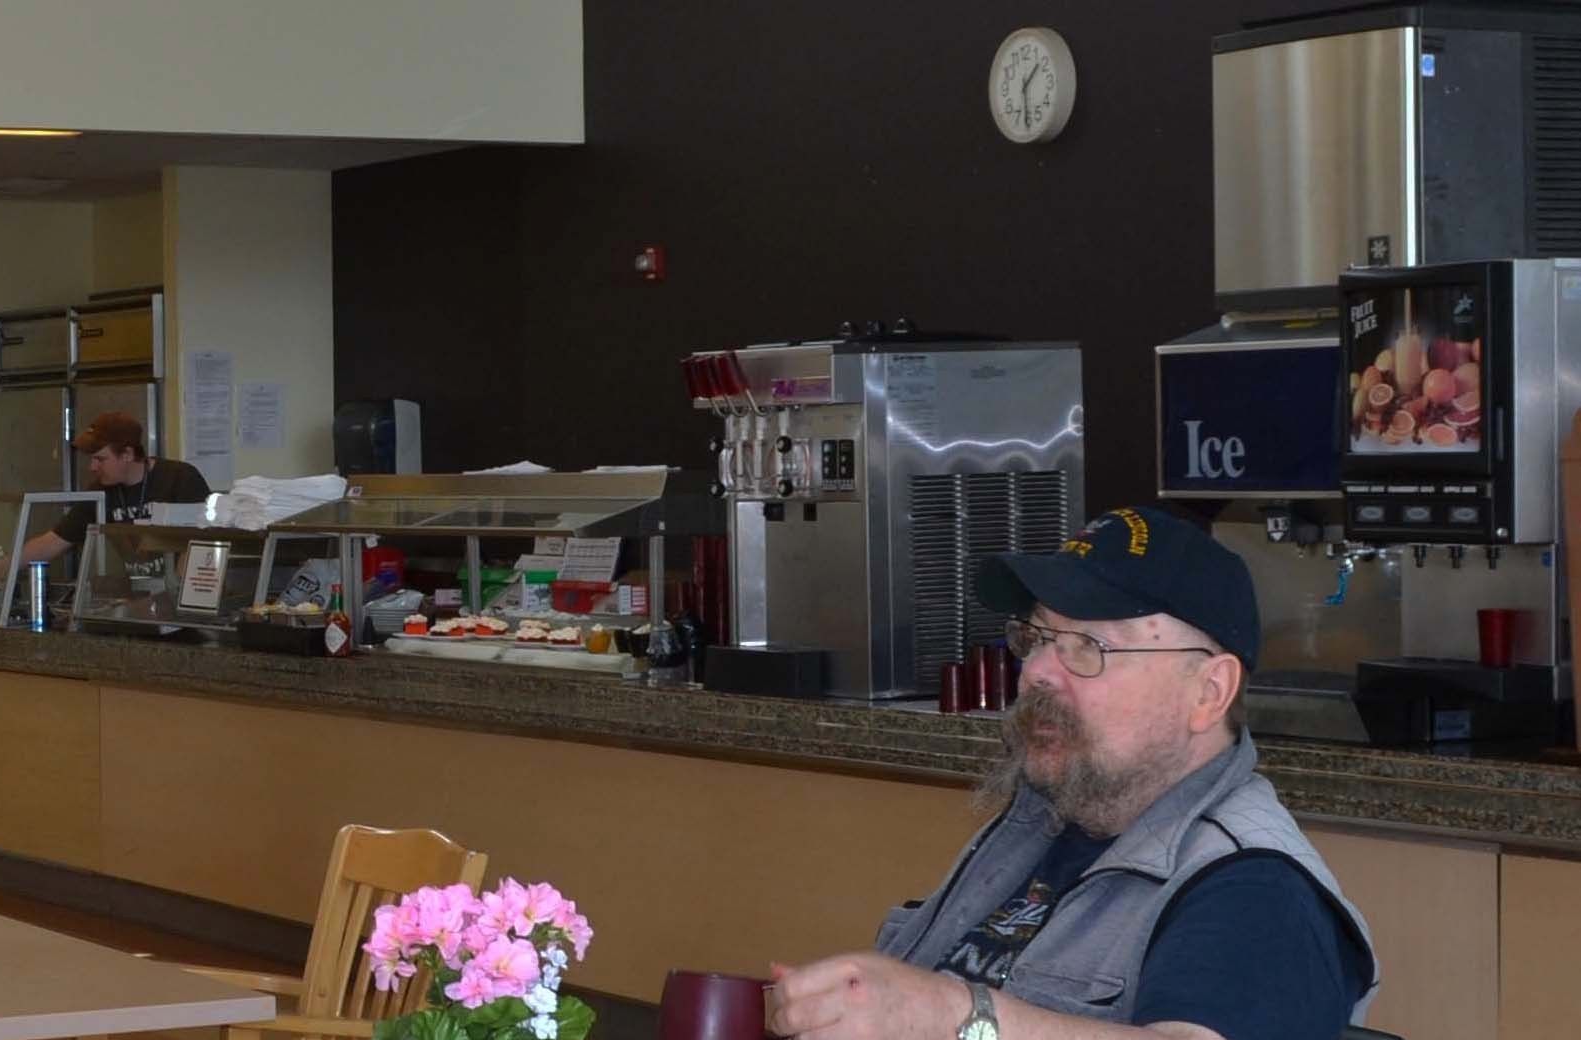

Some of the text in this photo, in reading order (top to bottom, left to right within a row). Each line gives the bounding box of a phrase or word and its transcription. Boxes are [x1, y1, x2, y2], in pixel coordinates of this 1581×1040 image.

[1011, 52, 1020, 65] 11
[1020, 44, 1032, 61] 12
[1040, 56, 1050, 73] 2
[1001, 81, 1009, 97] 9
[1045, 74, 1055, 91] 3
[1043, 93, 1051, 108] 4
[1013, 109, 1021, 126] 7
[1033, 105, 1042, 122] 5
[1184, 420, 1246, 479] Ice
